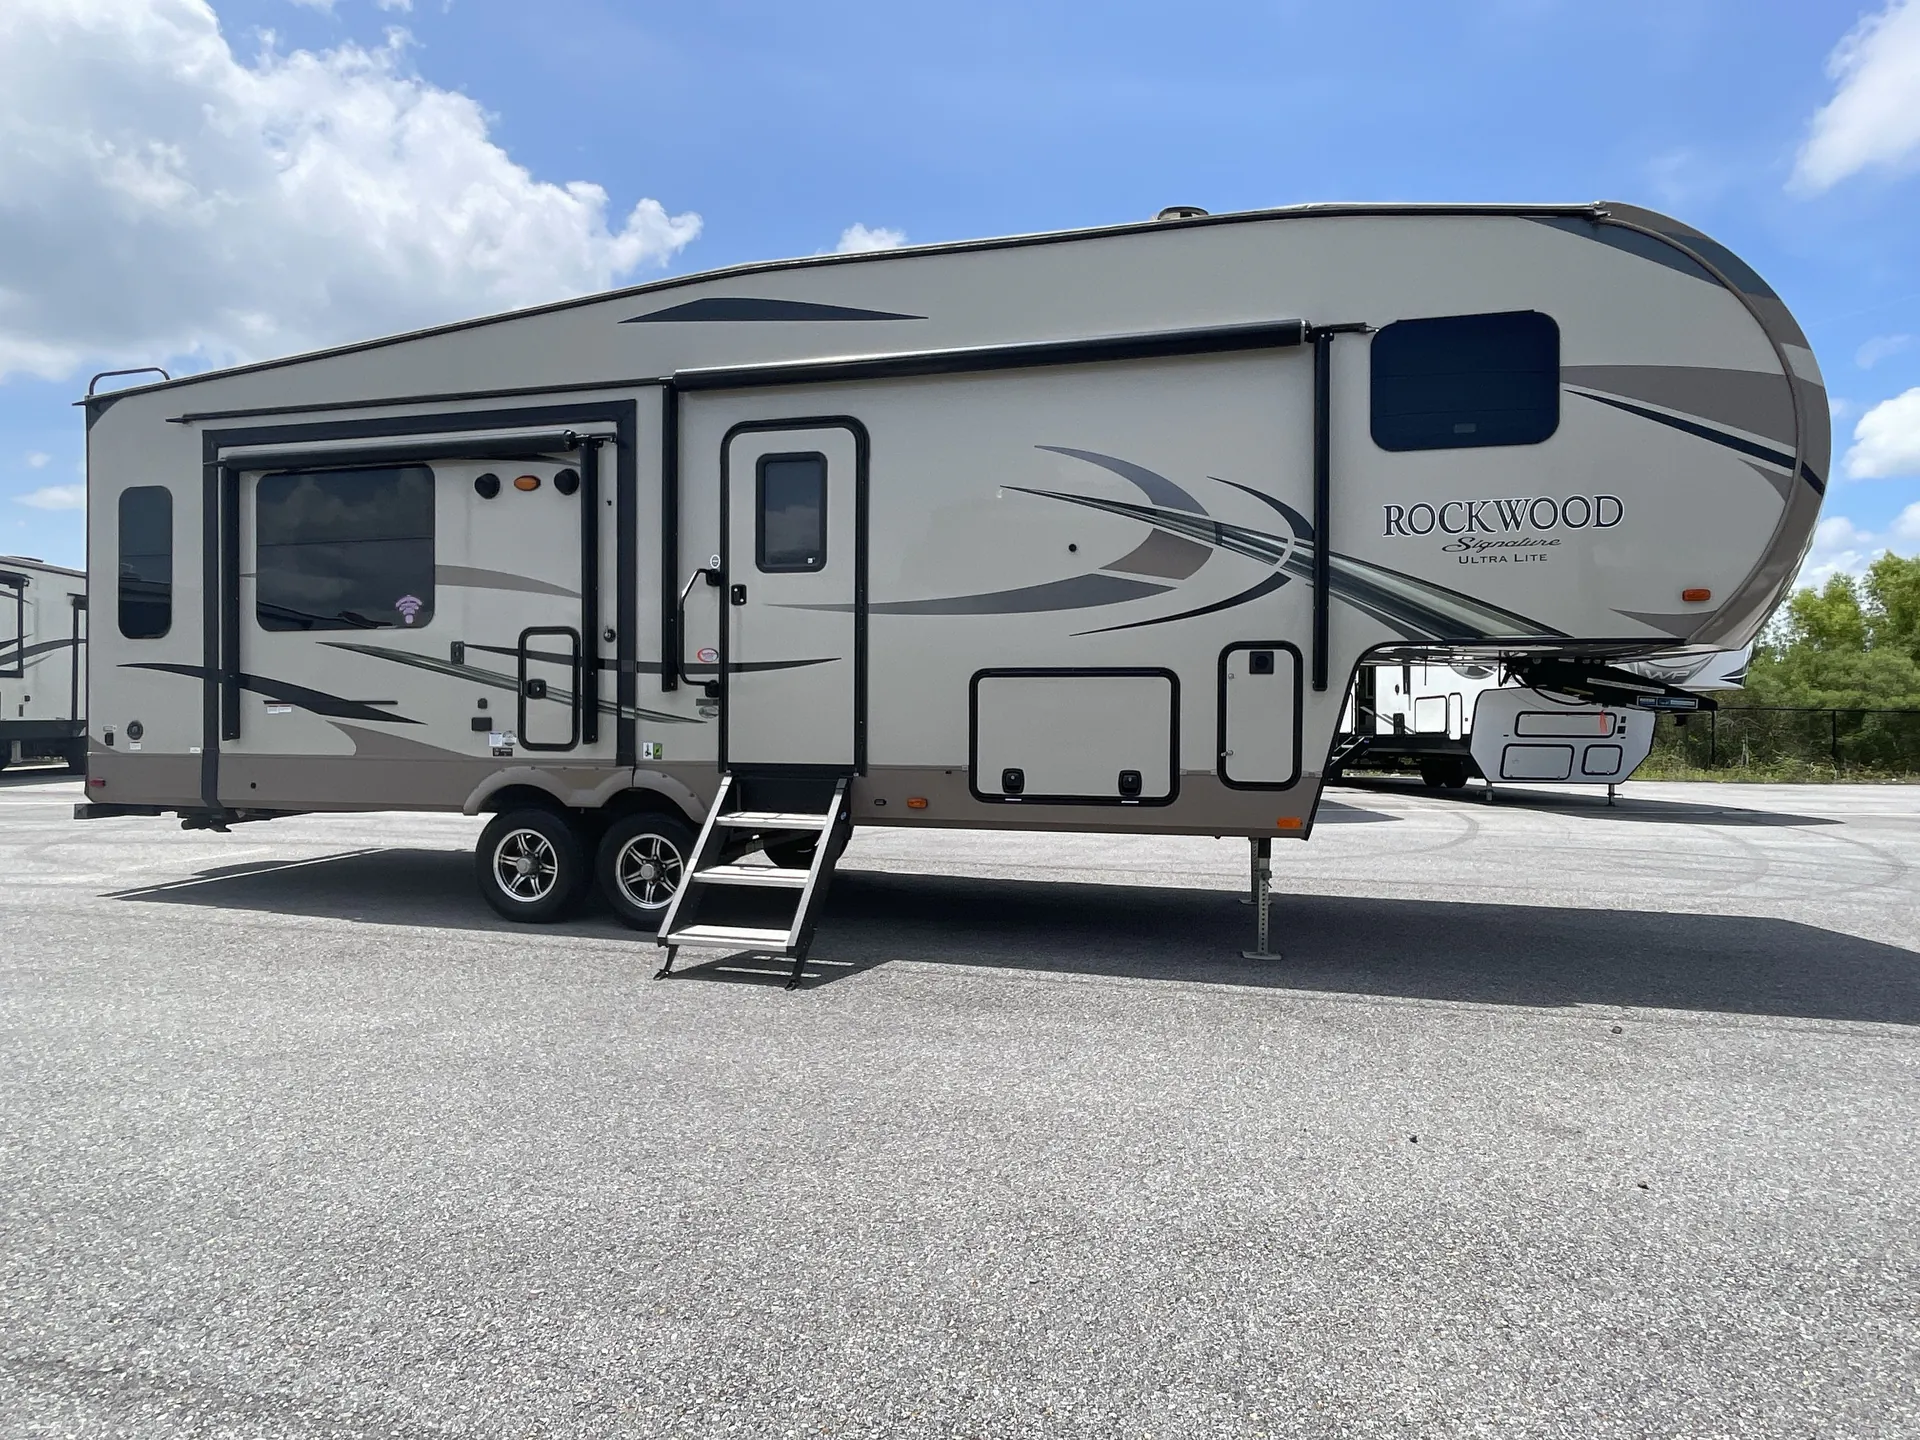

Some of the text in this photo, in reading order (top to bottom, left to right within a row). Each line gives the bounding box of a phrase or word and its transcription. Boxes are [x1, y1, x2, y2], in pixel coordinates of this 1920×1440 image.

[1382, 494, 1625, 537] ROCKWOOD
[1442, 537, 1562, 553] Signature
[1458, 553, 1548, 564] ULTRA LITE
